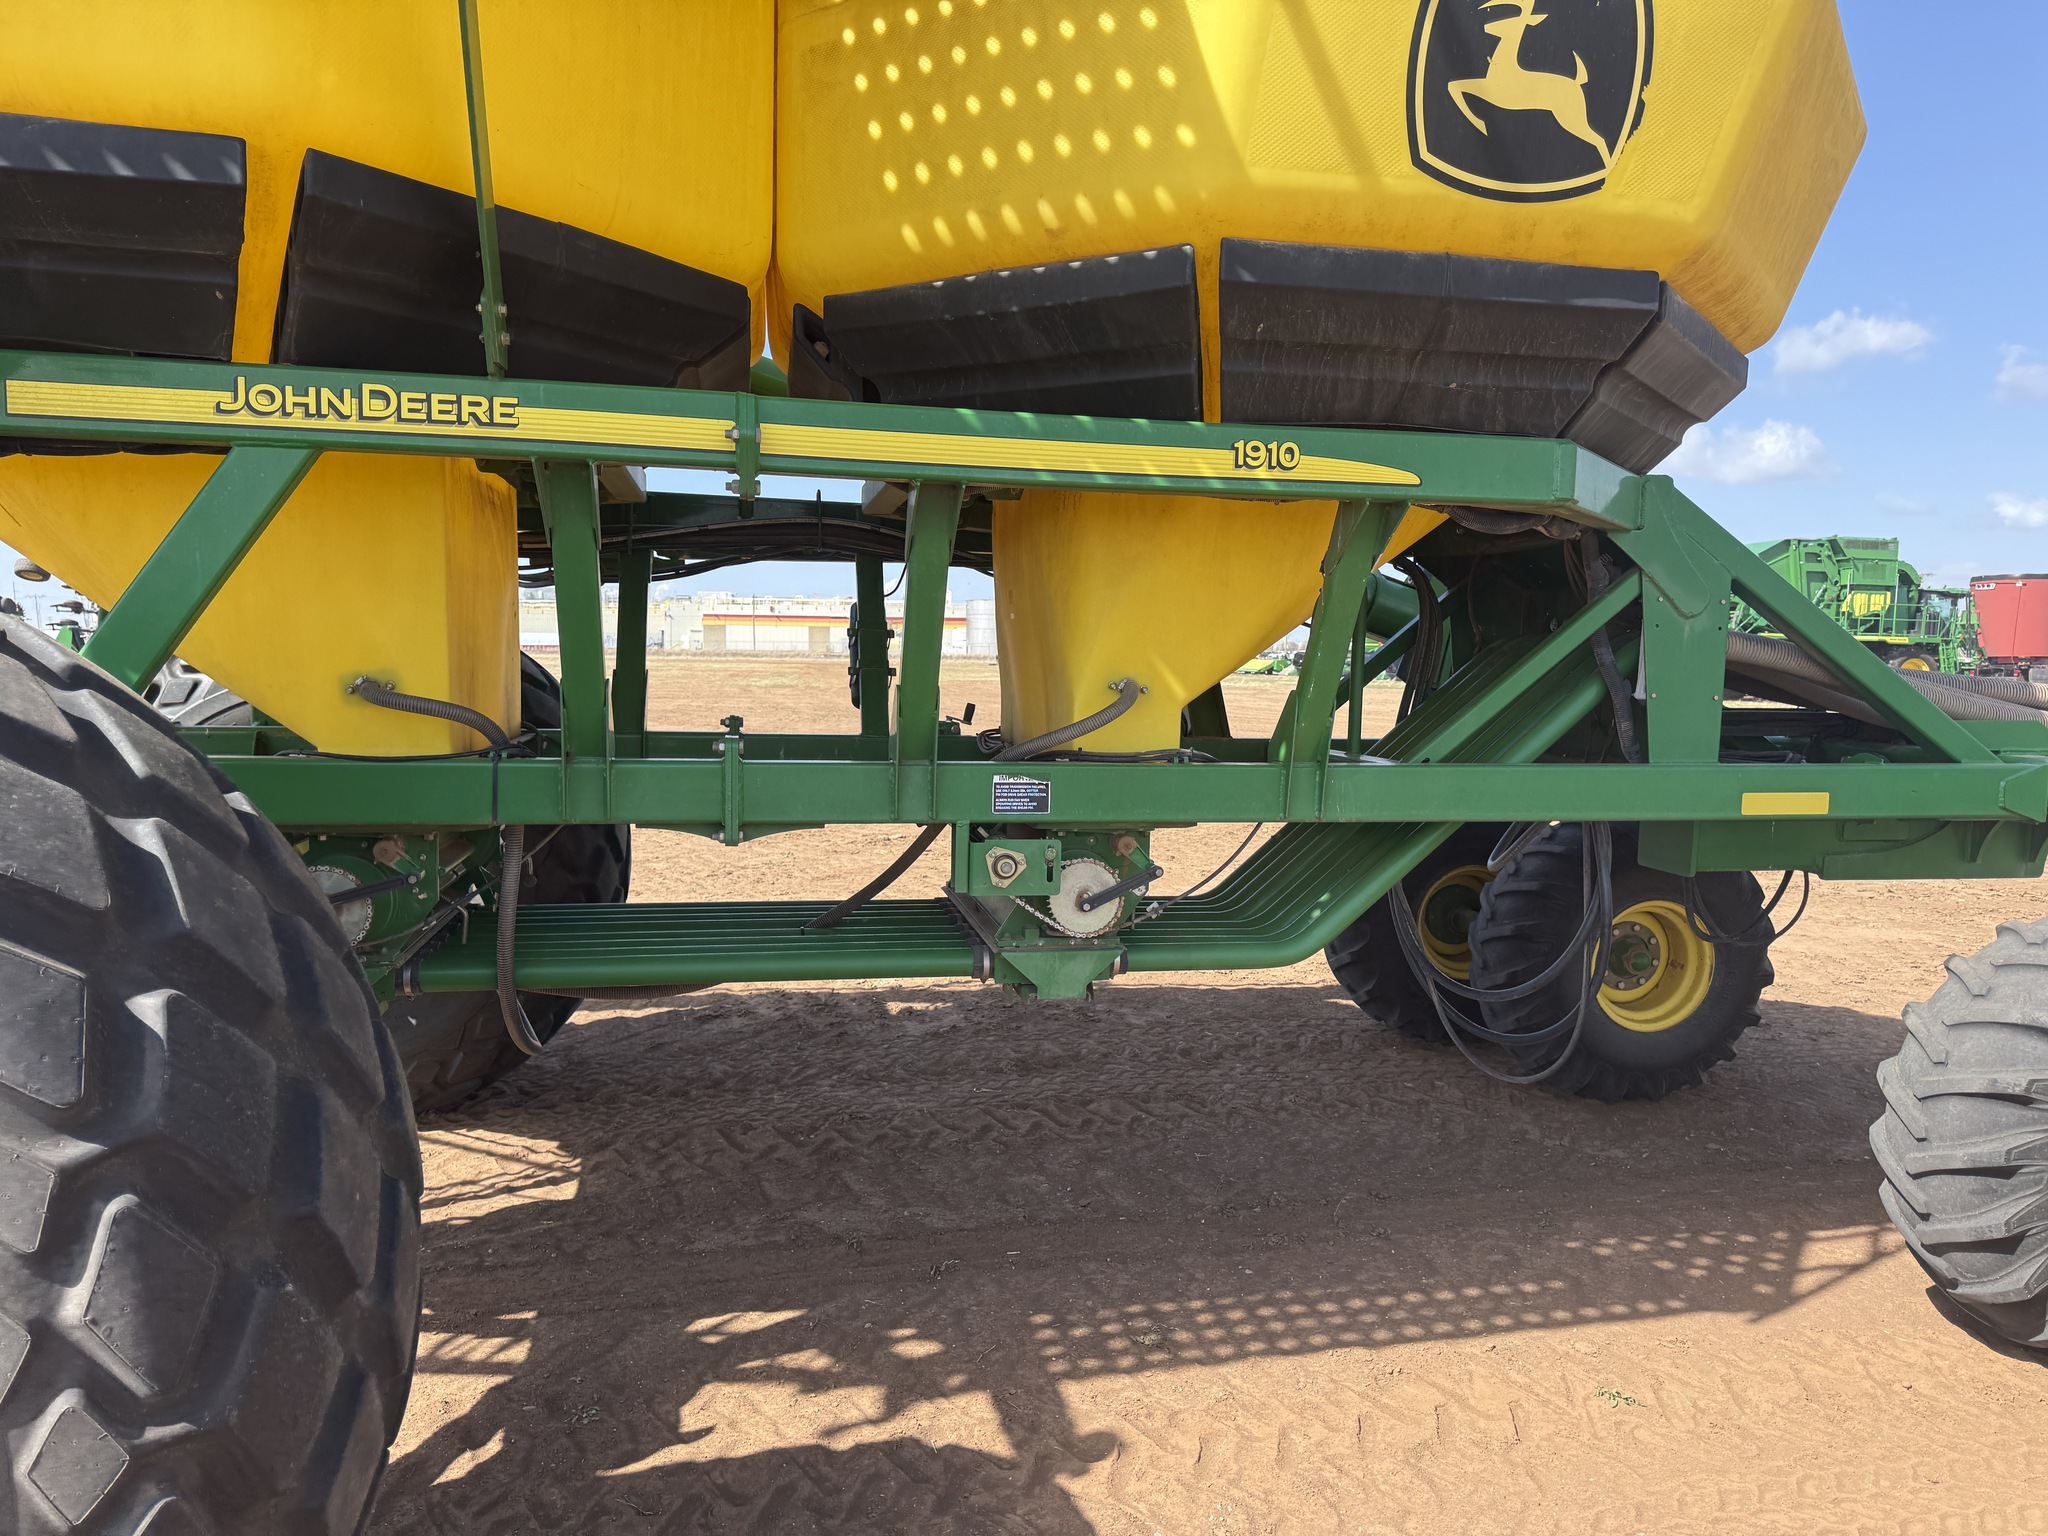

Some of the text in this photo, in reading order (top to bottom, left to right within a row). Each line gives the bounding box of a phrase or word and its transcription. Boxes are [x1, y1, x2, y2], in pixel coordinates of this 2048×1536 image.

[217, 375, 520, 427] JOHN DEERE
[1232, 439, 1302, 470] 1910
